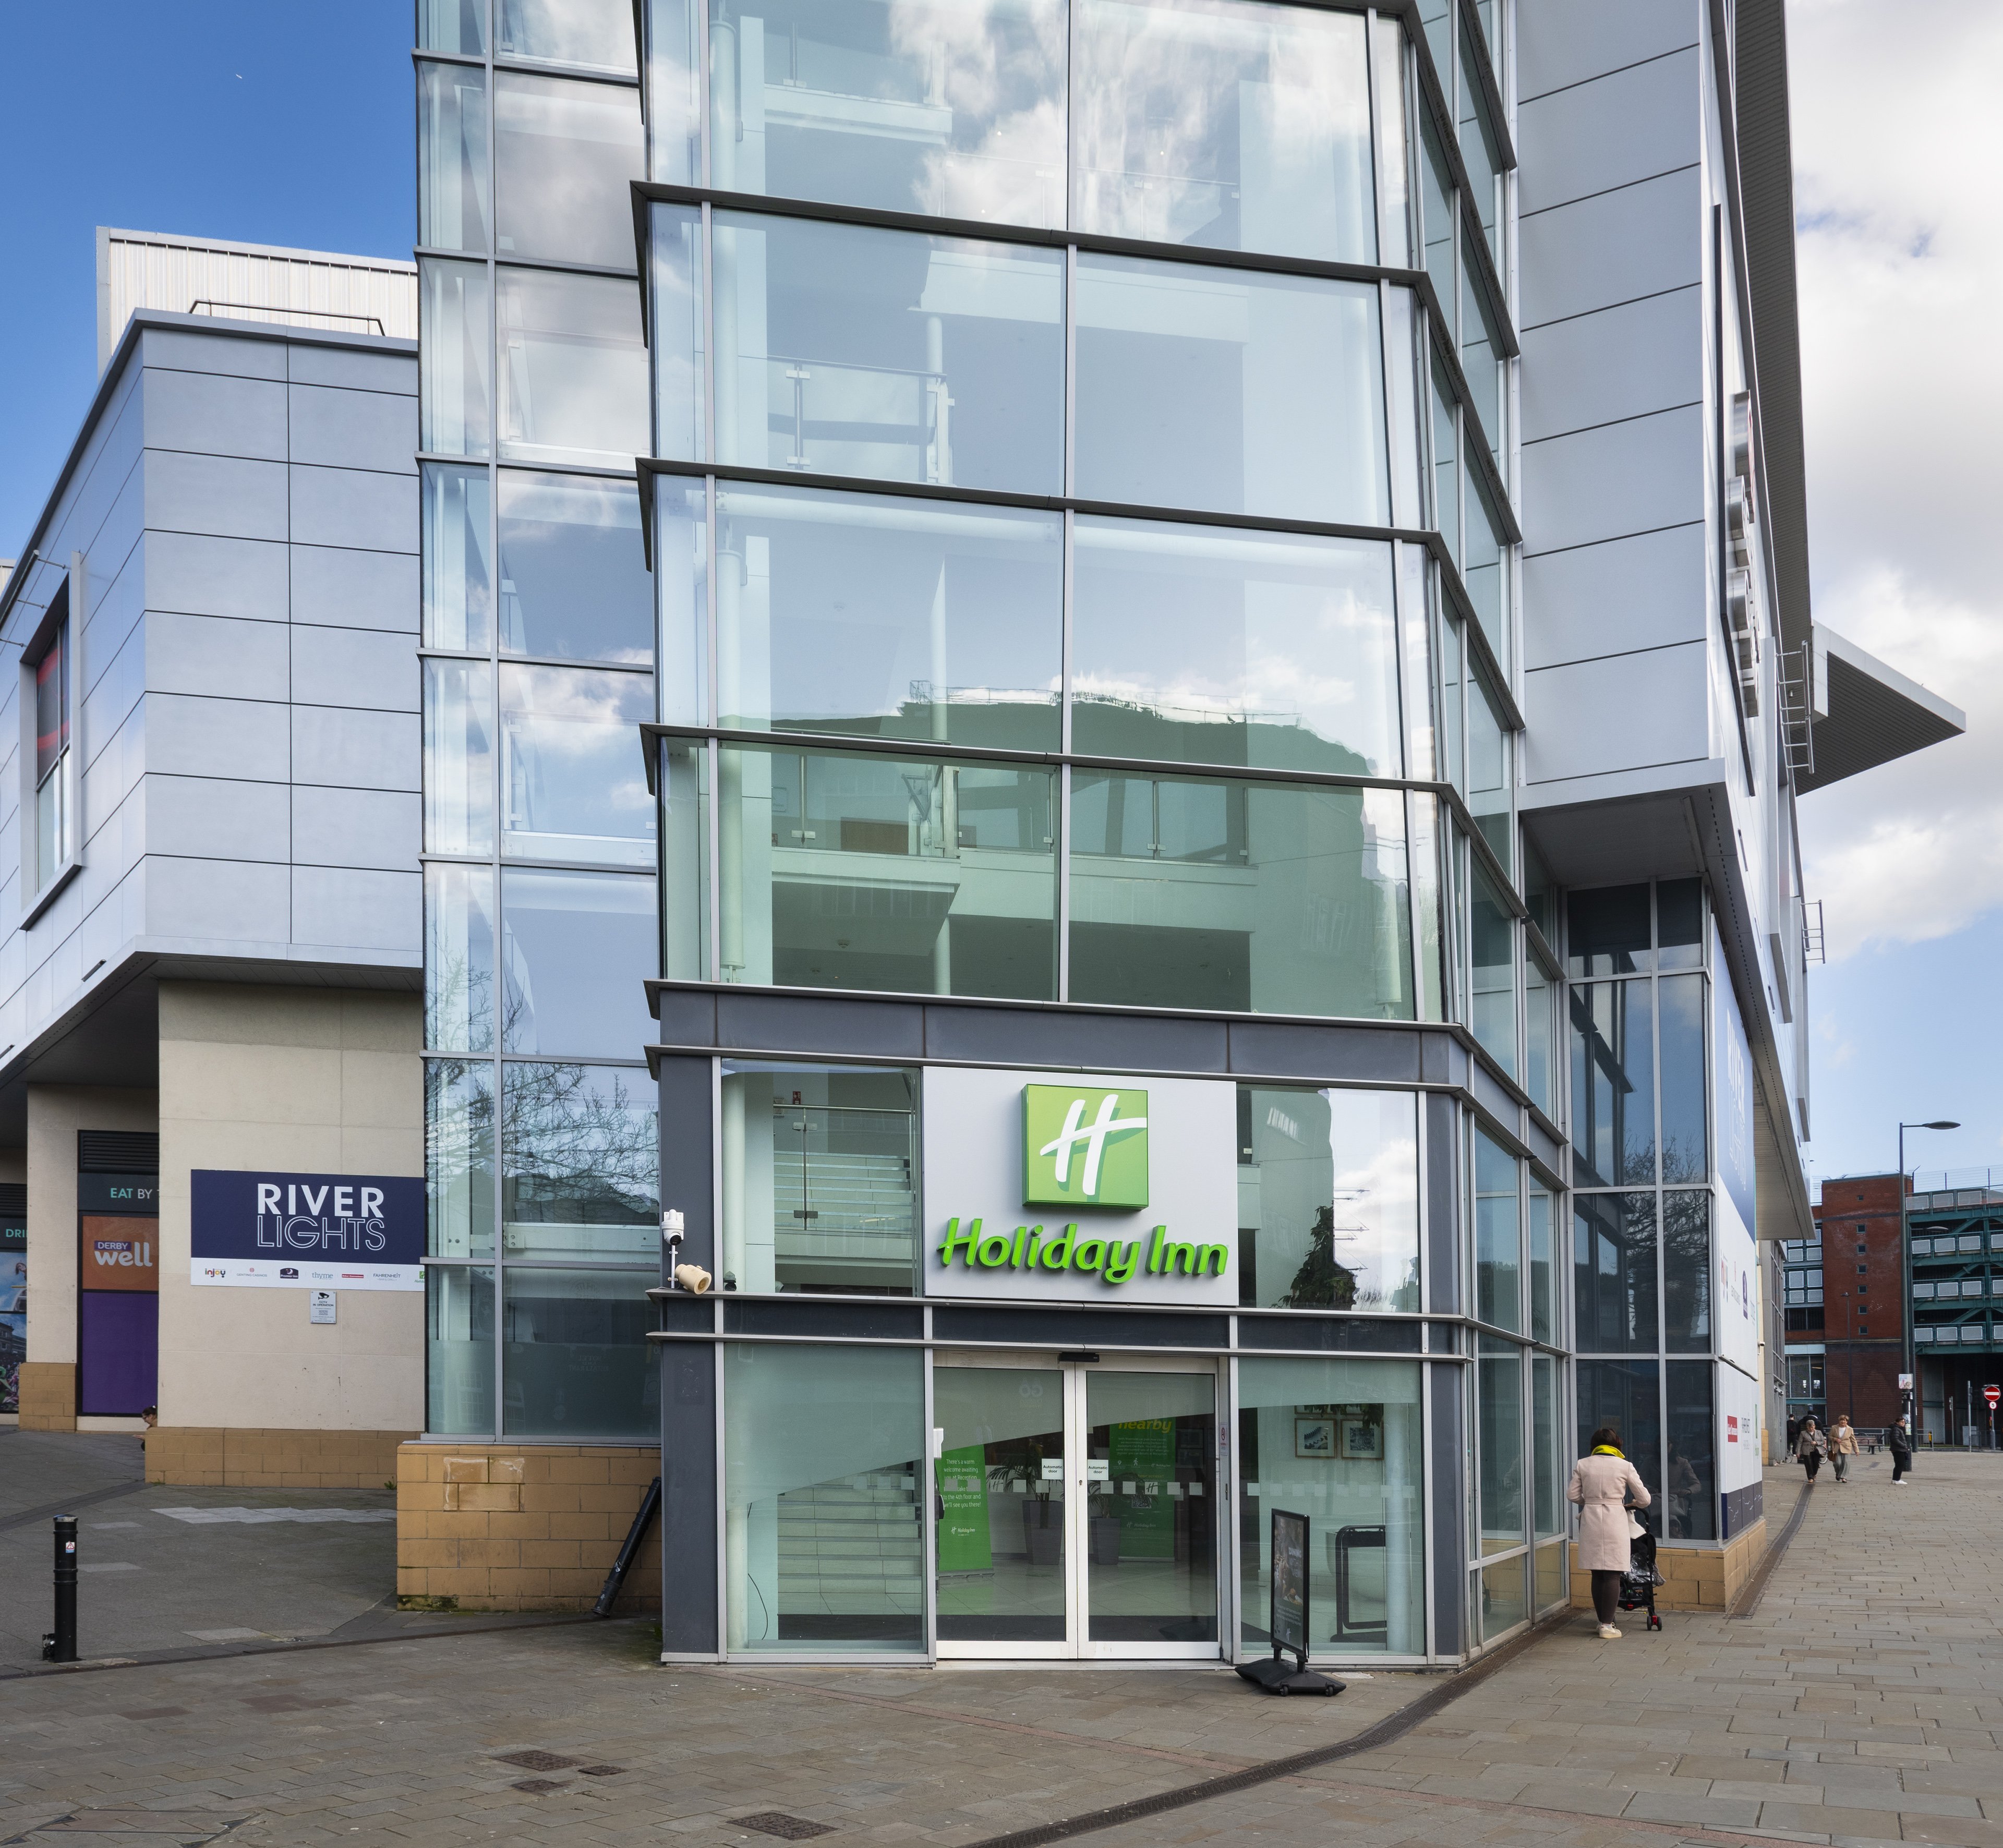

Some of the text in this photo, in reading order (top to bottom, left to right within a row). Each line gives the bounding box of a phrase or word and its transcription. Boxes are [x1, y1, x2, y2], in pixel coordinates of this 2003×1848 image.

[111, 1188, 133, 1199] EAT
[138, 1189, 153, 1199] BY
[258, 1183, 384, 1218] RIVER
[258, 1215, 385, 1251] LIGHTS
[94, 1242, 153, 1267] well
[936, 1217, 1229, 1285] Holiday Inn
[205, 1268, 226, 1278] injoy
[1118, 1419, 1172, 1433] nearby
